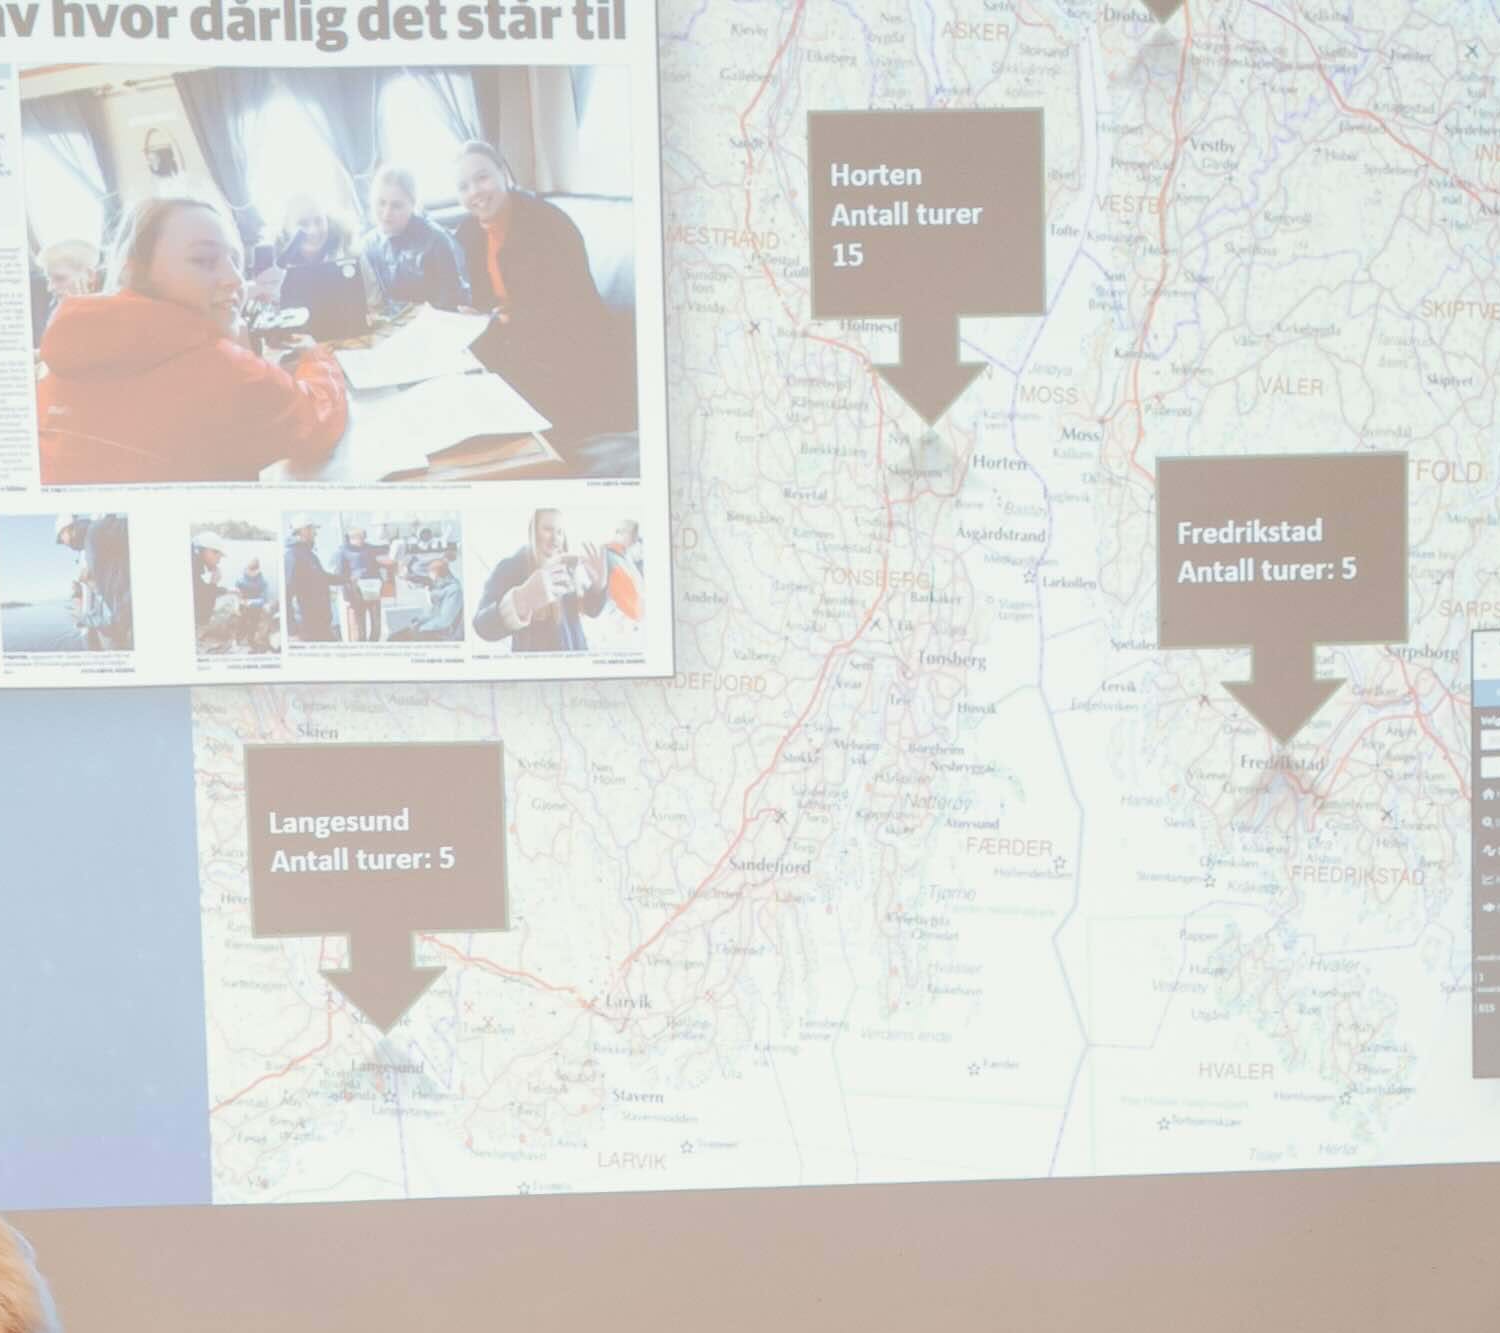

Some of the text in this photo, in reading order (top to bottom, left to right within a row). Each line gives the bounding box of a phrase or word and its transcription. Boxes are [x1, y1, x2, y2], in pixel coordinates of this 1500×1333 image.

[53, 0, 179, 39] hvor
[191, 0, 348, 52] dårlig
[358, 0, 448, 41] det
[458, 0, 561, 41] står
[571, 0, 627, 41] til
[830, 163, 922, 187] Horten
[831, 203, 983, 227] Antall turer
[1096, 195, 1163, 214] VESTB
[666, 223, 780, 251] MESTRAND
[832, 244, 864, 268] 15
[1020, 385, 1079, 405] MOSS
[1061, 428, 1100, 443] Moss
[971, 454, 1027, 473] Horten
[1409, 460, 1483, 485] TFOLD
[955, 524, 1047, 545] Åsgårdstrand
[1177, 517, 1324, 544] Fredrikstad
[1178, 558, 1358, 584] Antall turer: 5
[918, 648, 988, 673] Tønsberg
[269, 808, 409, 838] Langesund
[270, 847, 456, 873] Antall turer: 5
[966, 838, 1053, 859] FÆRDER
[728, 857, 812, 877] Sandefjord
[1289, 866, 1425, 886] FREDRIKSTAD
[1198, 1063, 1275, 1080] HVALER
[597, 1152, 667, 1172] LARVIK
